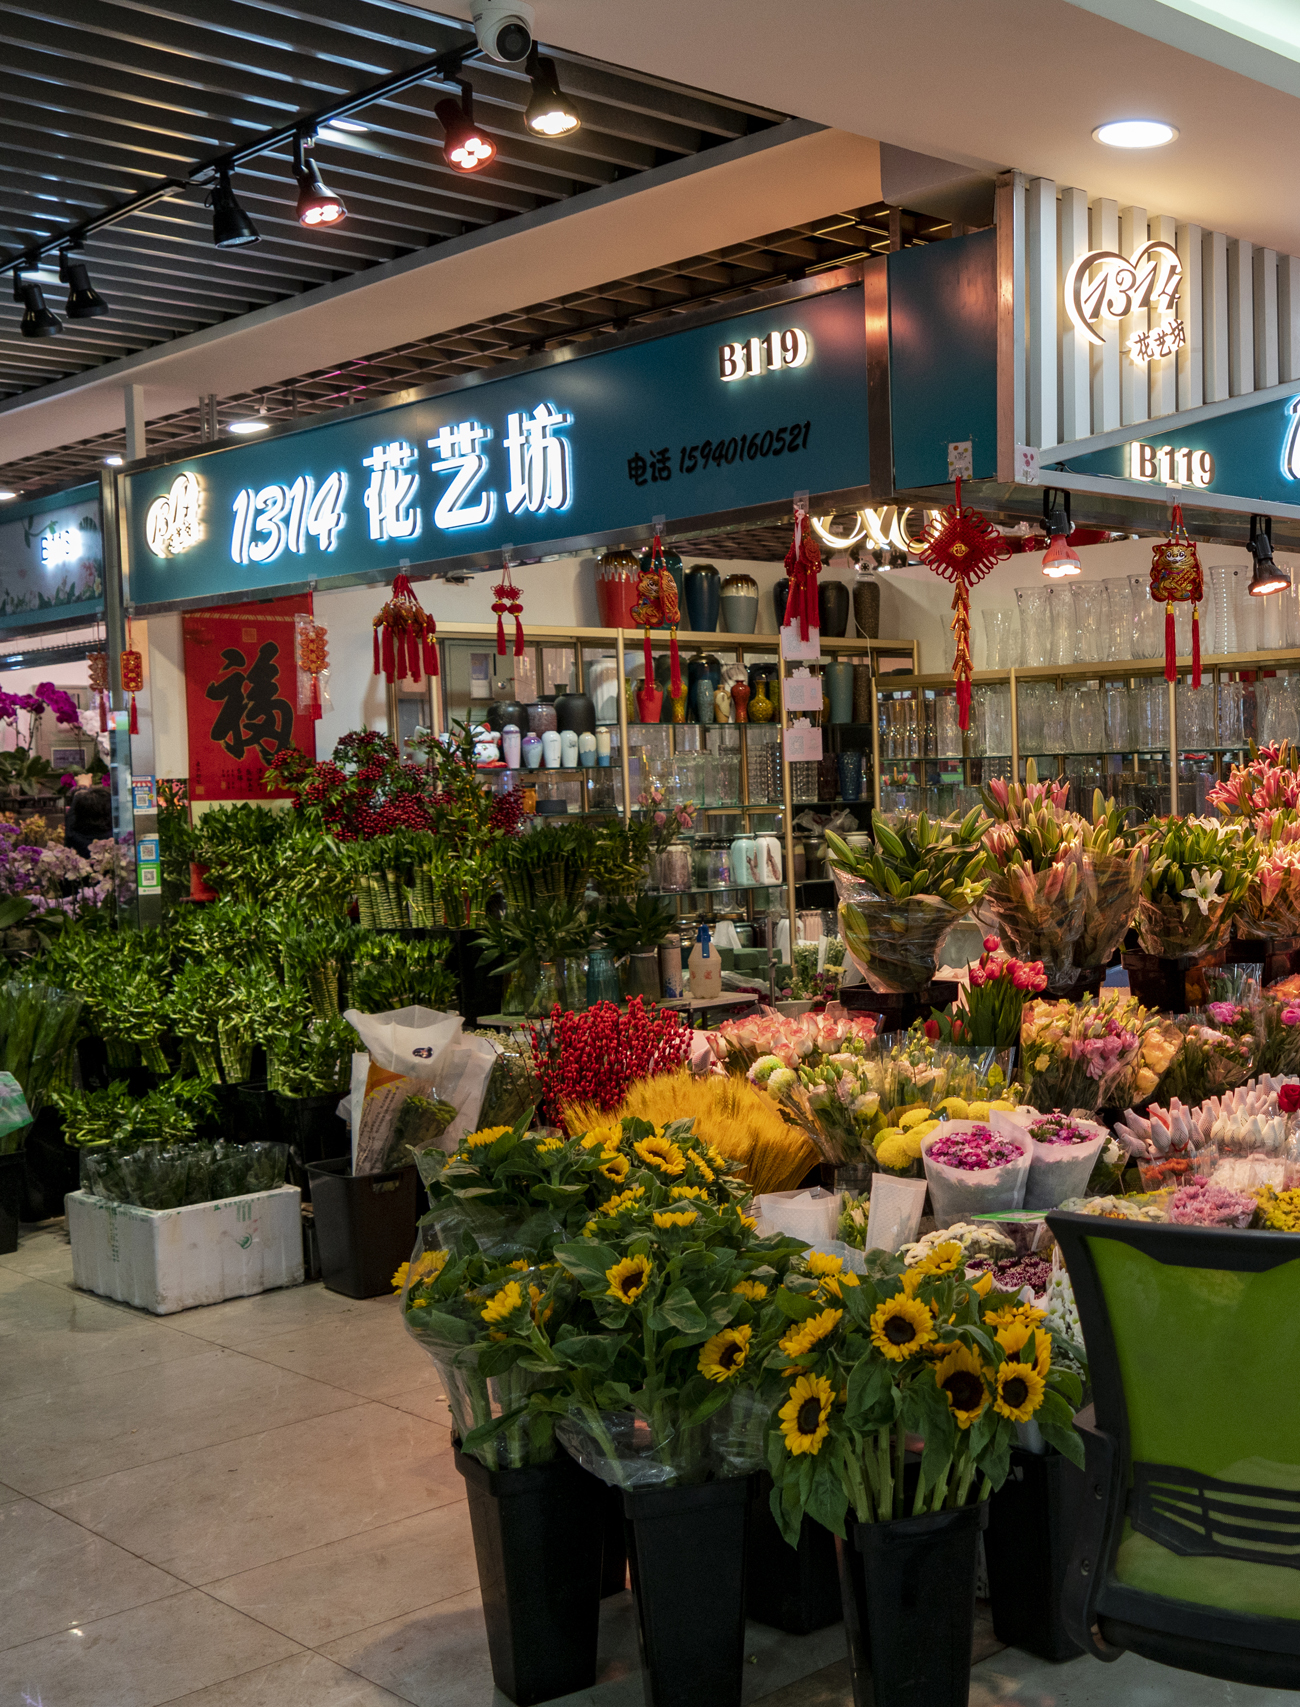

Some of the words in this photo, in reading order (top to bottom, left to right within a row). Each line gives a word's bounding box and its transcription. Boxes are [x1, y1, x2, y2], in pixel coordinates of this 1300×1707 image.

[1084, 262, 1183, 321] 1314
[718, 328, 807, 381] B119
[1134, 319, 1186, 360] 花艺坊
[627, 452, 672, 487] 电话
[679, 420, 811, 474] 15940160521
[1132, 442, 1216, 488] B119
[231, 471, 348, 564] 1314
[363, 403, 575, 541] 花艺坊
[205, 641, 294, 768] 福
